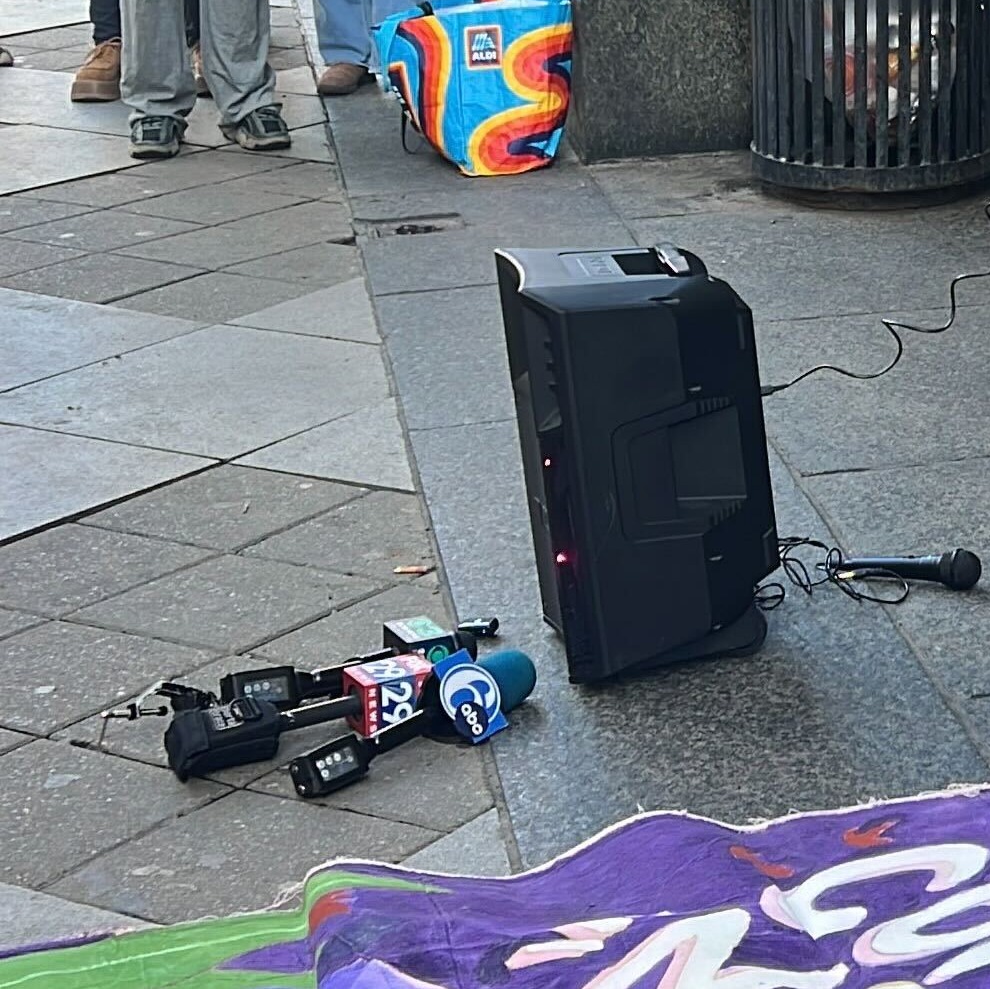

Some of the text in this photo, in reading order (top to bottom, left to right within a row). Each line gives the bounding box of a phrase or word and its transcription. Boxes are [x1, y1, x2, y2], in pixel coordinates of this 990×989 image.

[472, 51, 497, 61] ALDI
[381, 681, 413, 724] 29
[461, 703, 484, 736] abc
